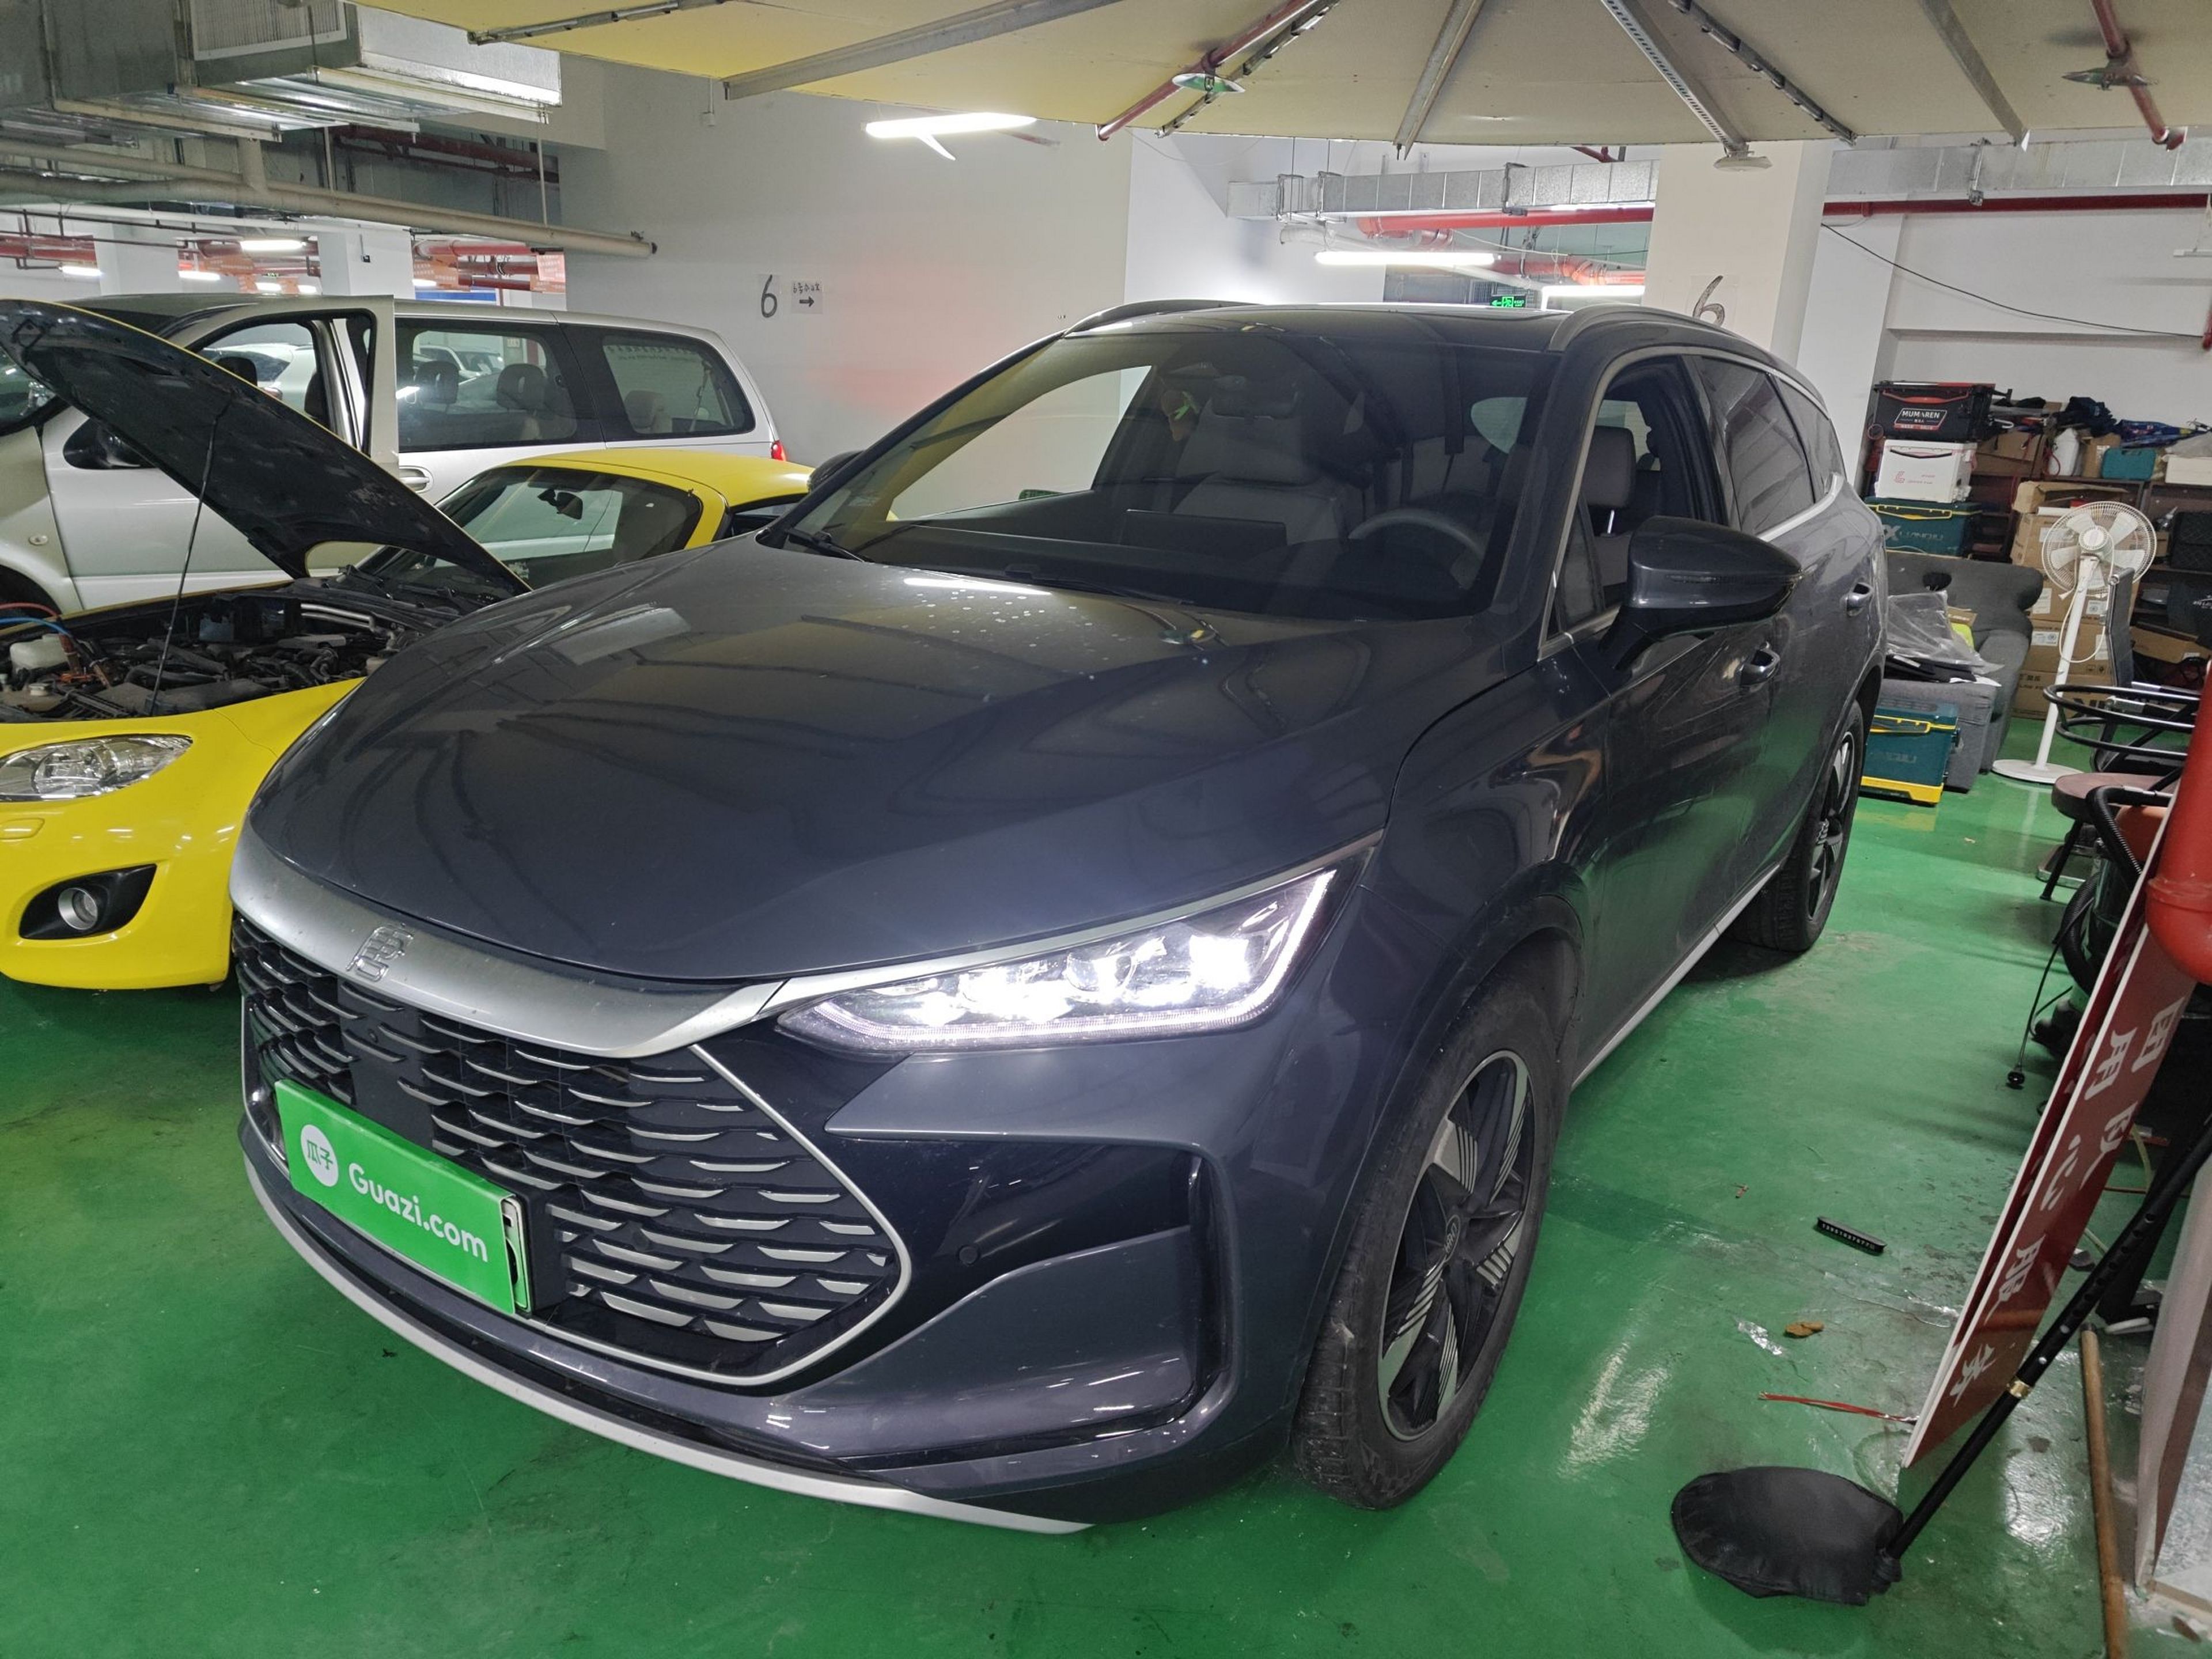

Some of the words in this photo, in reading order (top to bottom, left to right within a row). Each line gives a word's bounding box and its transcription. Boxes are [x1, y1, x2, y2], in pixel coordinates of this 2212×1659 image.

[761, 274, 778, 318] 6
[1692, 275, 1725, 327] 6
[306, 1139, 334, 1172] 瓜子
[348, 1162, 488, 1263] Guazi.com
[1949, 1027, 2138, 1408] 用心服务
